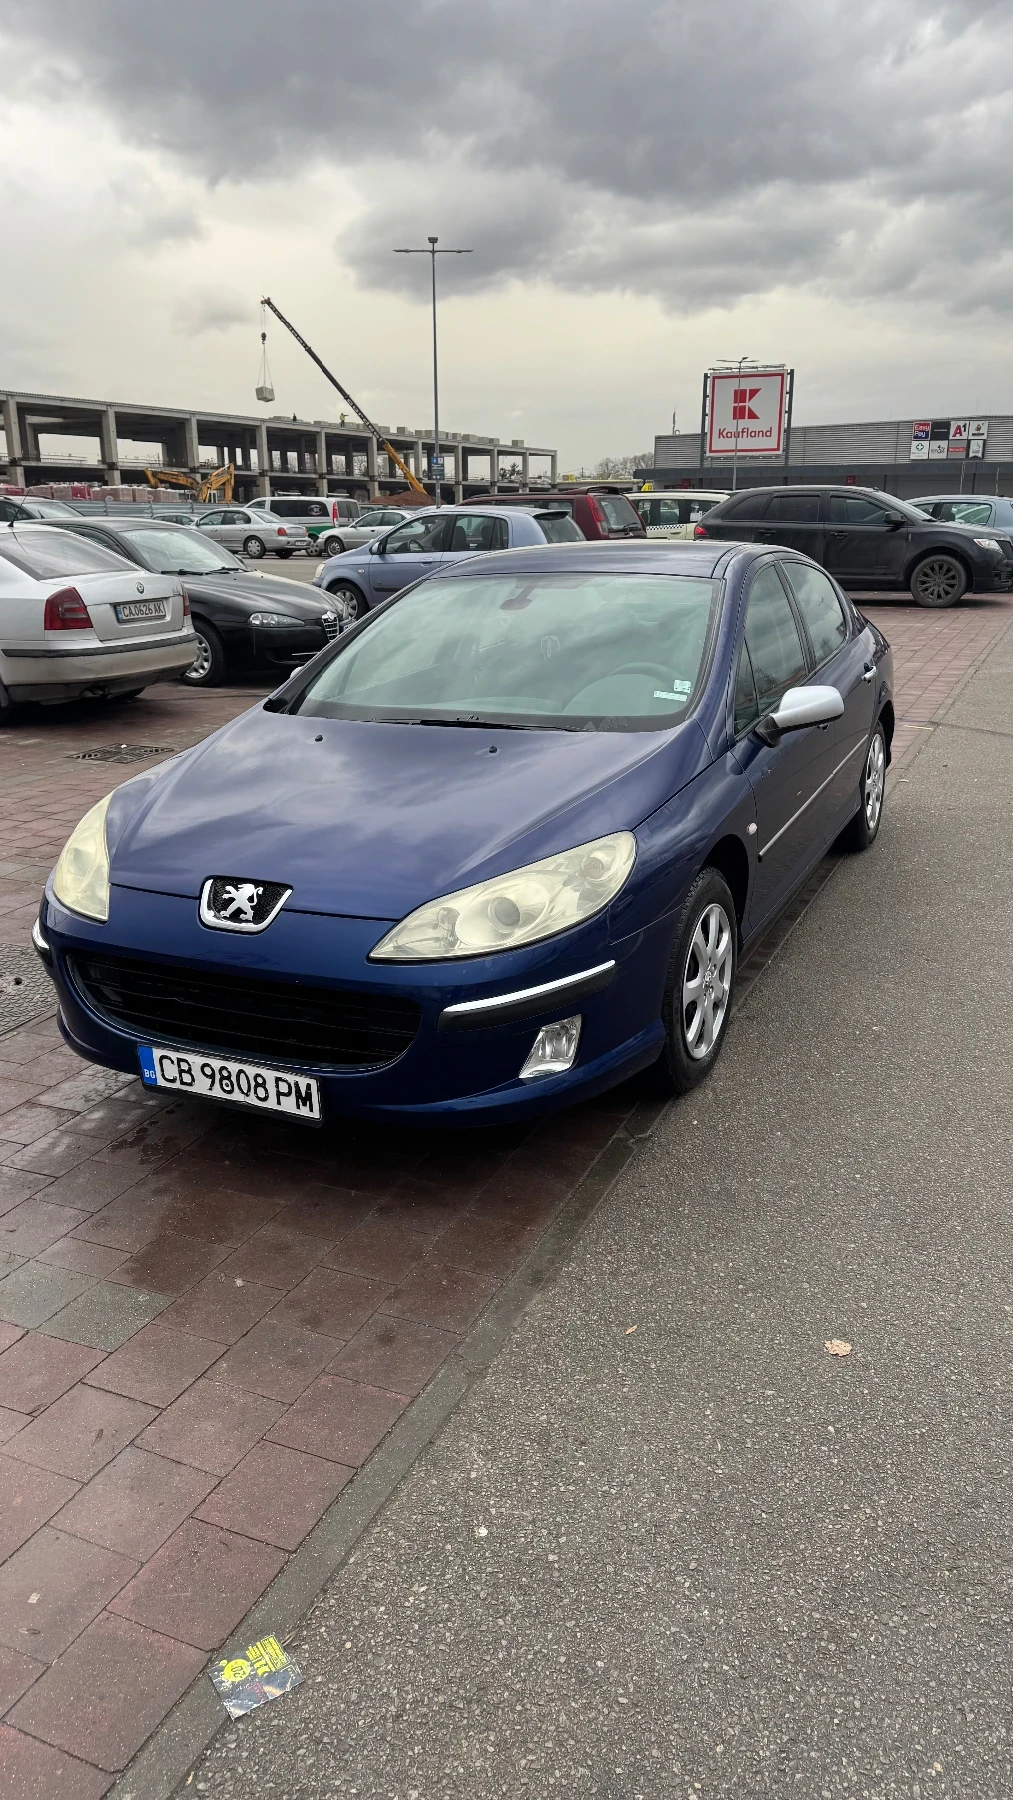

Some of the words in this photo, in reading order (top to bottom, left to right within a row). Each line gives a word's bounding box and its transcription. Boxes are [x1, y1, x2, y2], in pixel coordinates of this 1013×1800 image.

[718, 427, 772, 439] Kaufland
[952, 422, 967, 438] A1
[122, 606, 134, 618] CA
[134, 604, 153, 616] 0626
[154, 602, 164, 615] AK
[144, 1069, 156, 1079] BG
[158, 1054, 196, 1087] CB
[200, 1062, 270, 1102] 9808
[274, 1076, 314, 1113] PM
